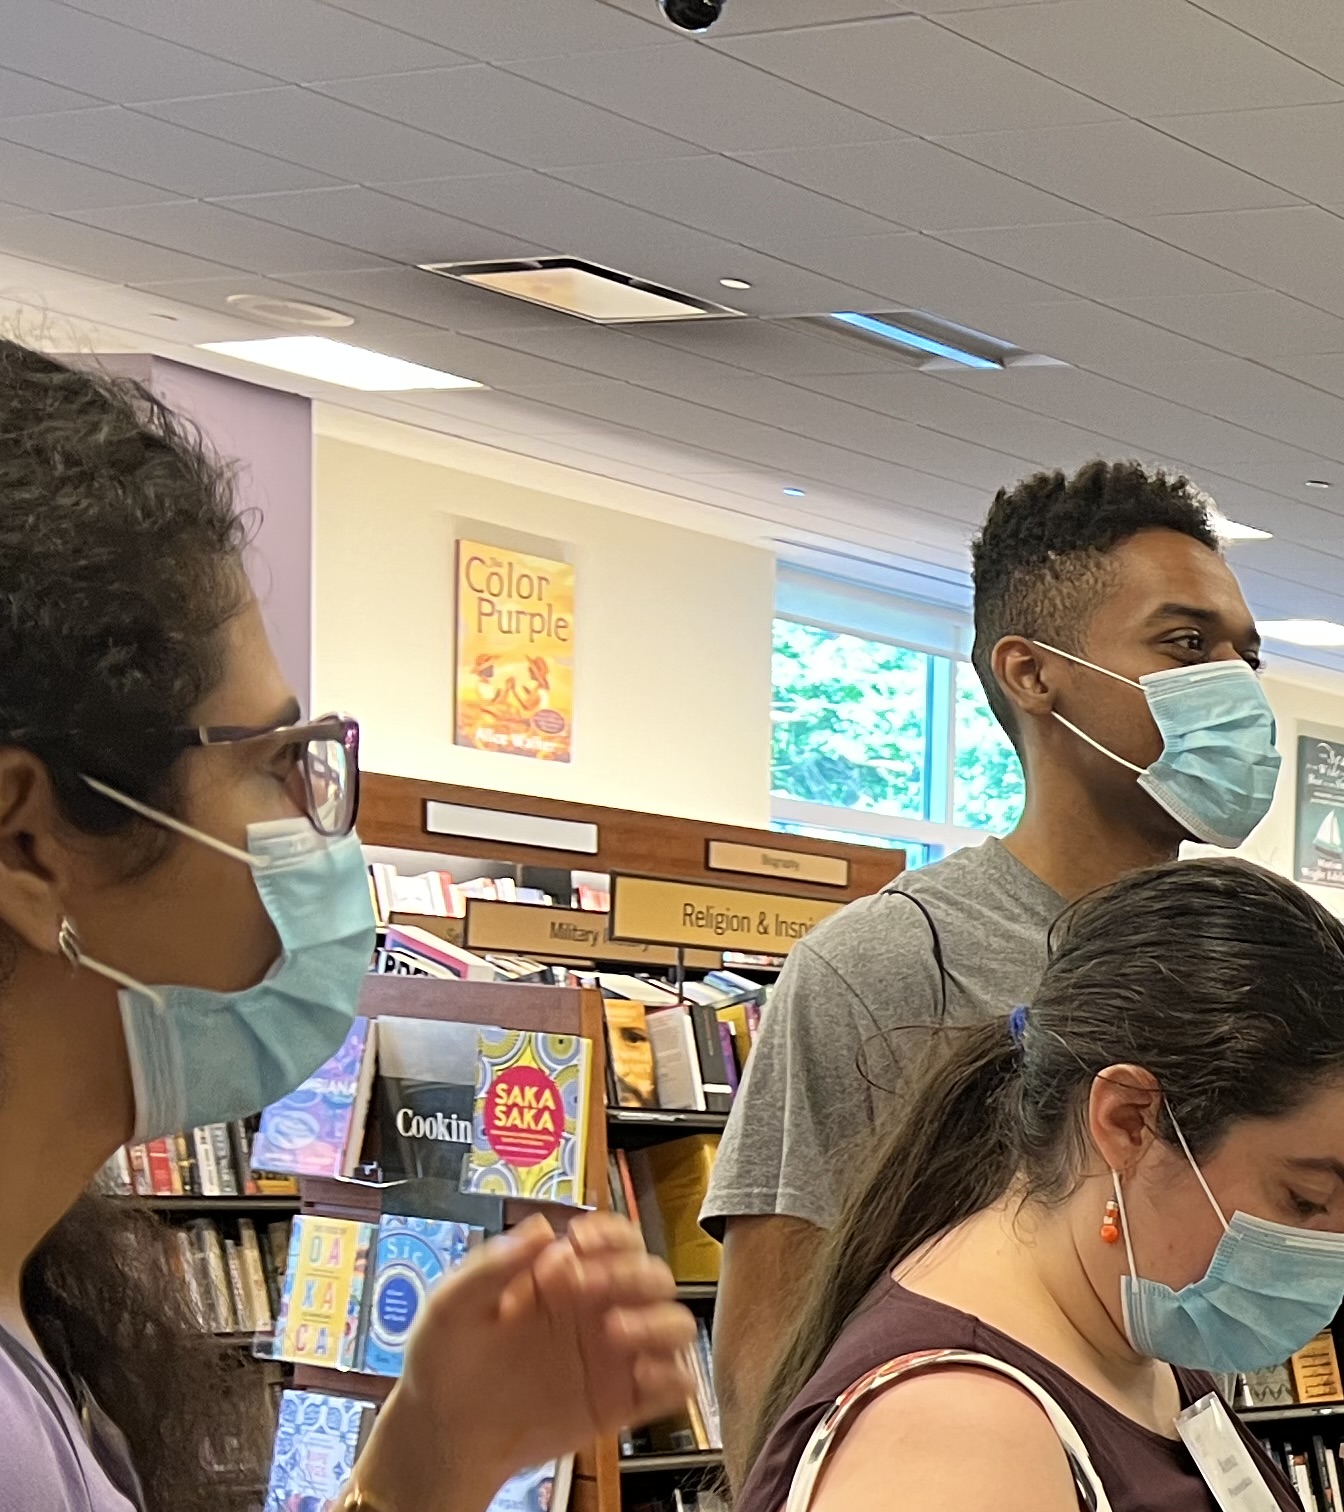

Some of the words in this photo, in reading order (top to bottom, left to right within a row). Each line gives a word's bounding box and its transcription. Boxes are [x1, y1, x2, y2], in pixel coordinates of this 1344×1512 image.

[465, 556, 551, 602] Color
[476, 597, 570, 643] Purple
[550, 921, 599, 947] Military
[682, 902, 751, 936] Religion
[756, 911, 770, 936] &
[494, 1082, 556, 1110] SAKA
[395, 1107, 473, 1144] Cookin
[493, 1105, 555, 1133] SAKA
